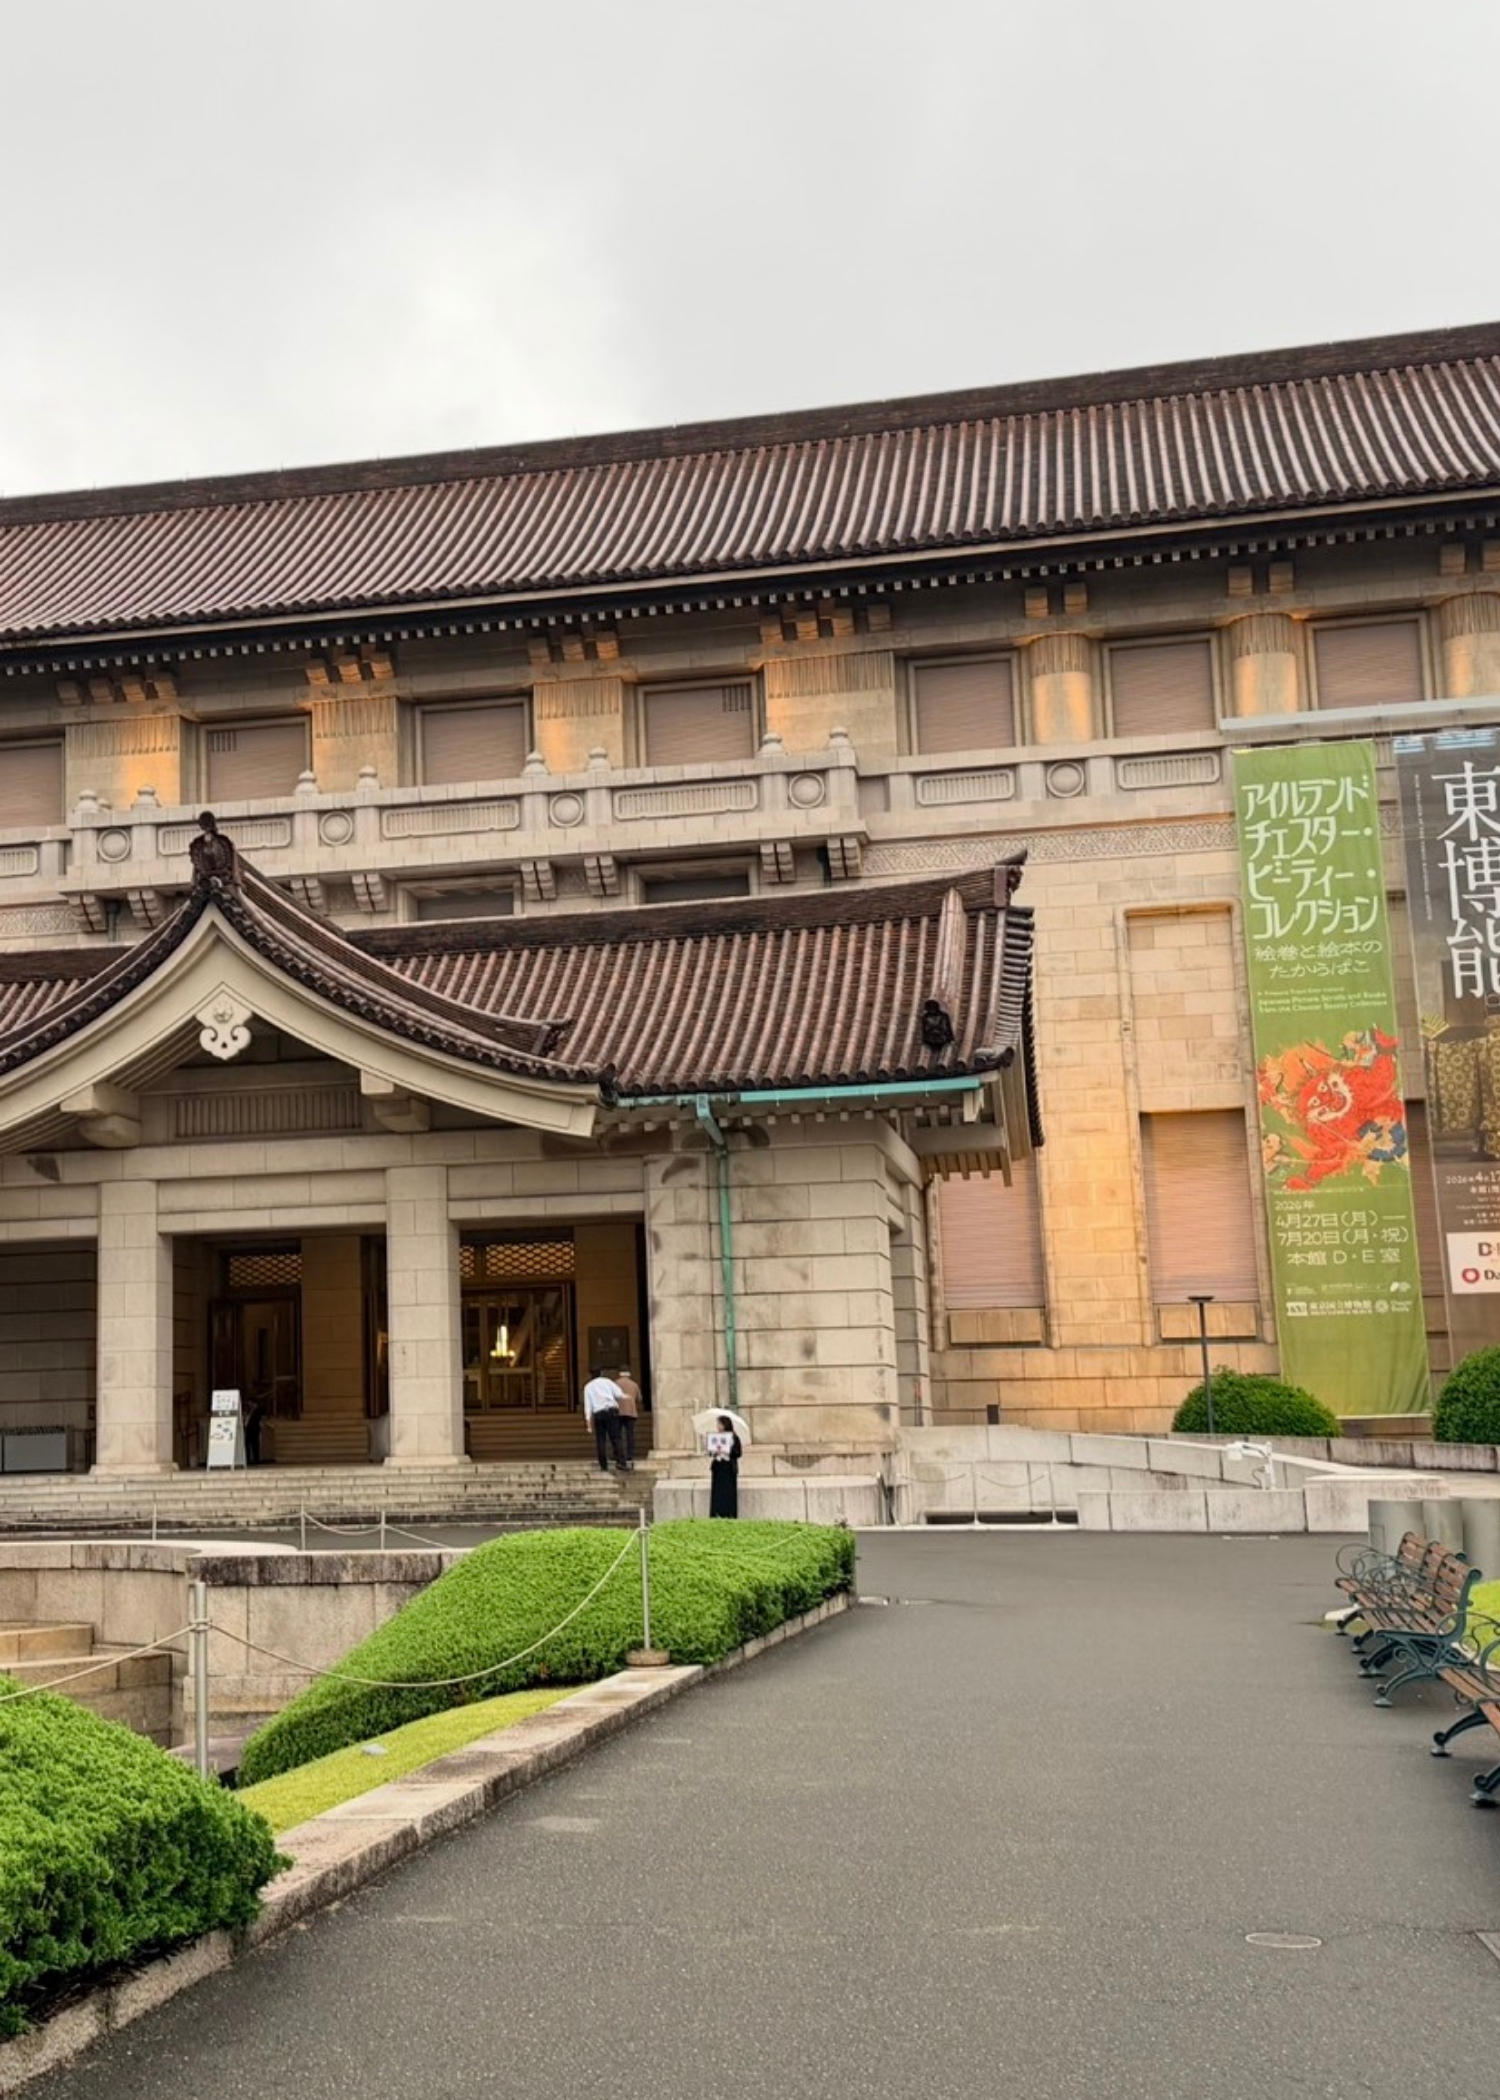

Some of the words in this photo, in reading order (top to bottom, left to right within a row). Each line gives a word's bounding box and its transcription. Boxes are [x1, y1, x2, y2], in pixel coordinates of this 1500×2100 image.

[1241, 774, 1369, 820] アイルランド
[1250, 895, 1378, 939] コレクション
[1269, 958, 1371, 979] たからばこ
